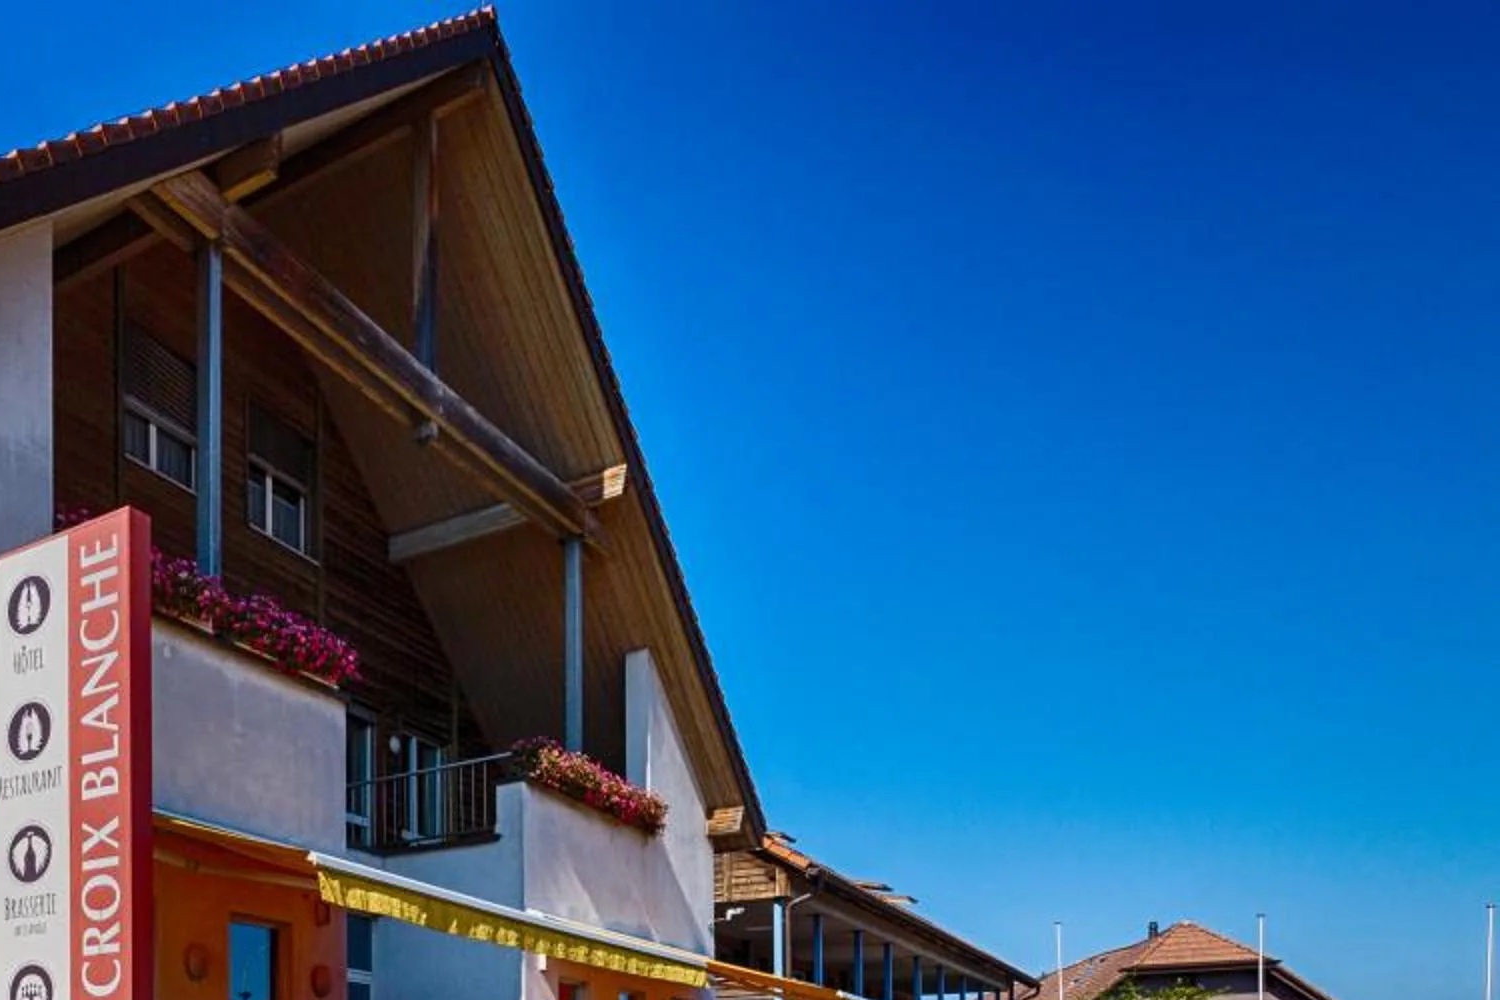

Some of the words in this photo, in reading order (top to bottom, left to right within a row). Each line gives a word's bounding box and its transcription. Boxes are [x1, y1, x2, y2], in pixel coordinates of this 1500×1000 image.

[13, 646, 45, 676] HÔTEL
[79, 532, 120, 802] BLANCHE
[4, 892, 58, 921] BRASSERIE
[81, 815, 121, 998] CROIX
